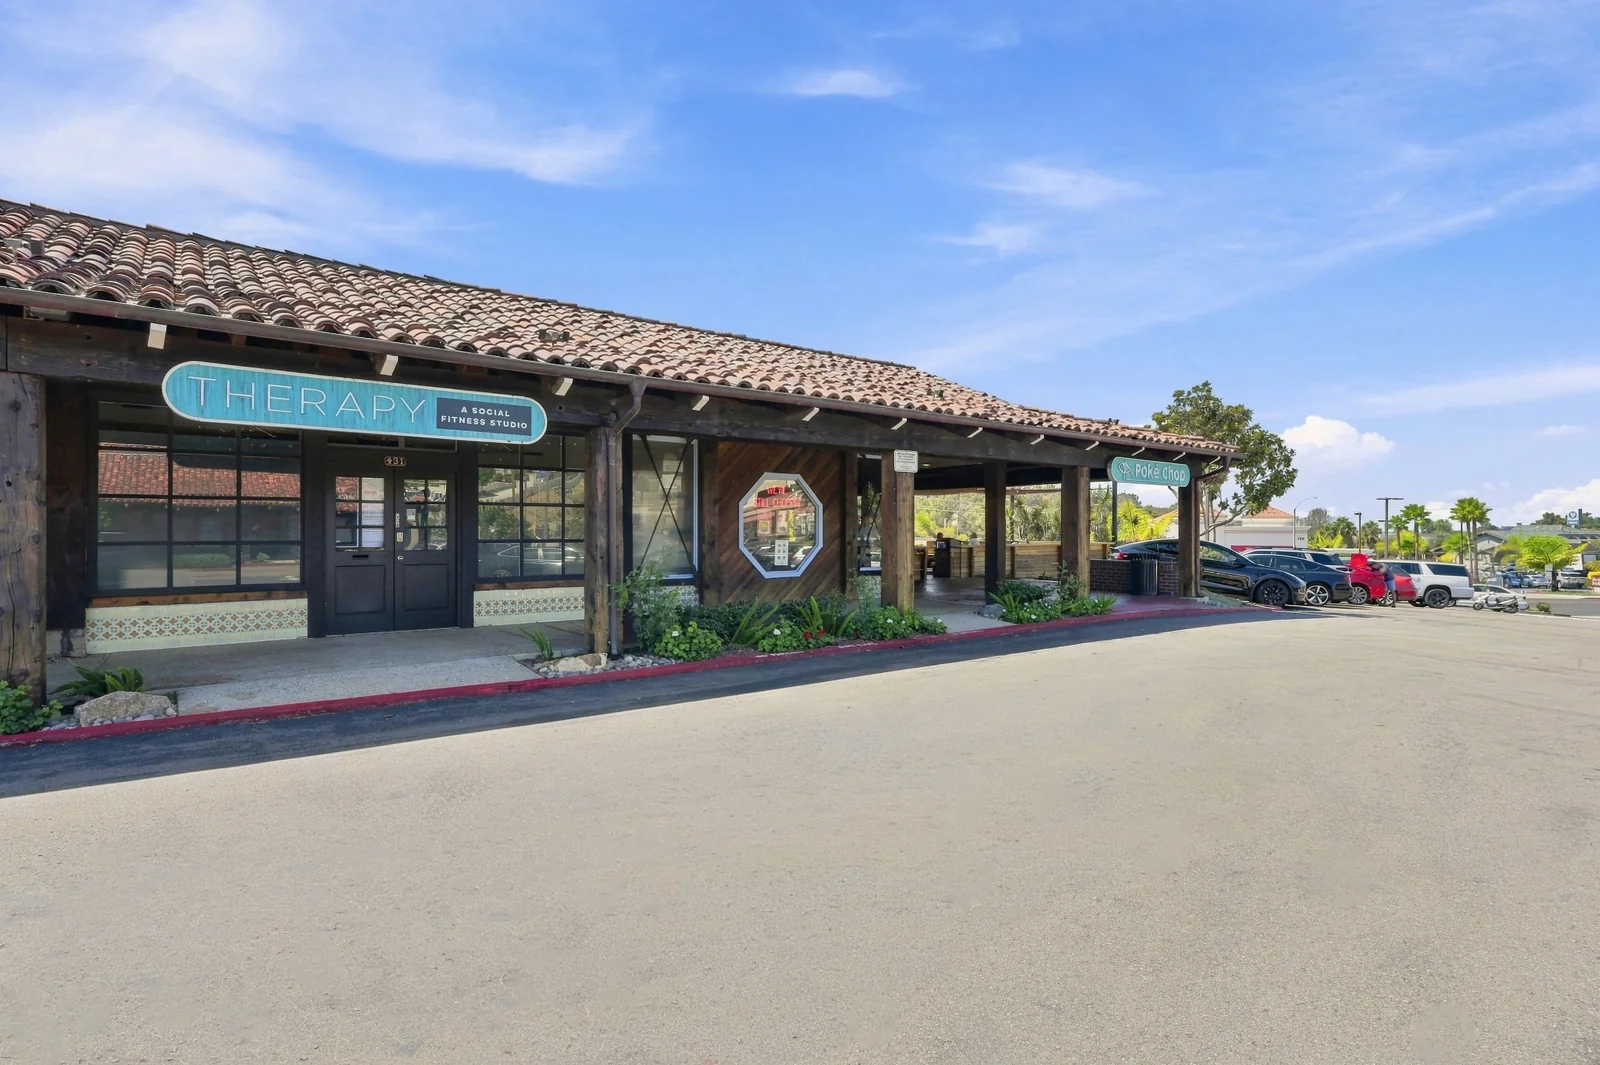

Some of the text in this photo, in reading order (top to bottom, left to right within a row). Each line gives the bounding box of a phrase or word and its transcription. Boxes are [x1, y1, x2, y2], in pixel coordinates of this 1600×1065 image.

[188, 376, 425, 424] THERAPY
[461, 406, 510, 417] A SOCIAL
[441, 415, 528, 429] FITNESS STUDIO
[386, 456, 404, 465] 431
[1135, 463, 1186, 485] Poké Chop
